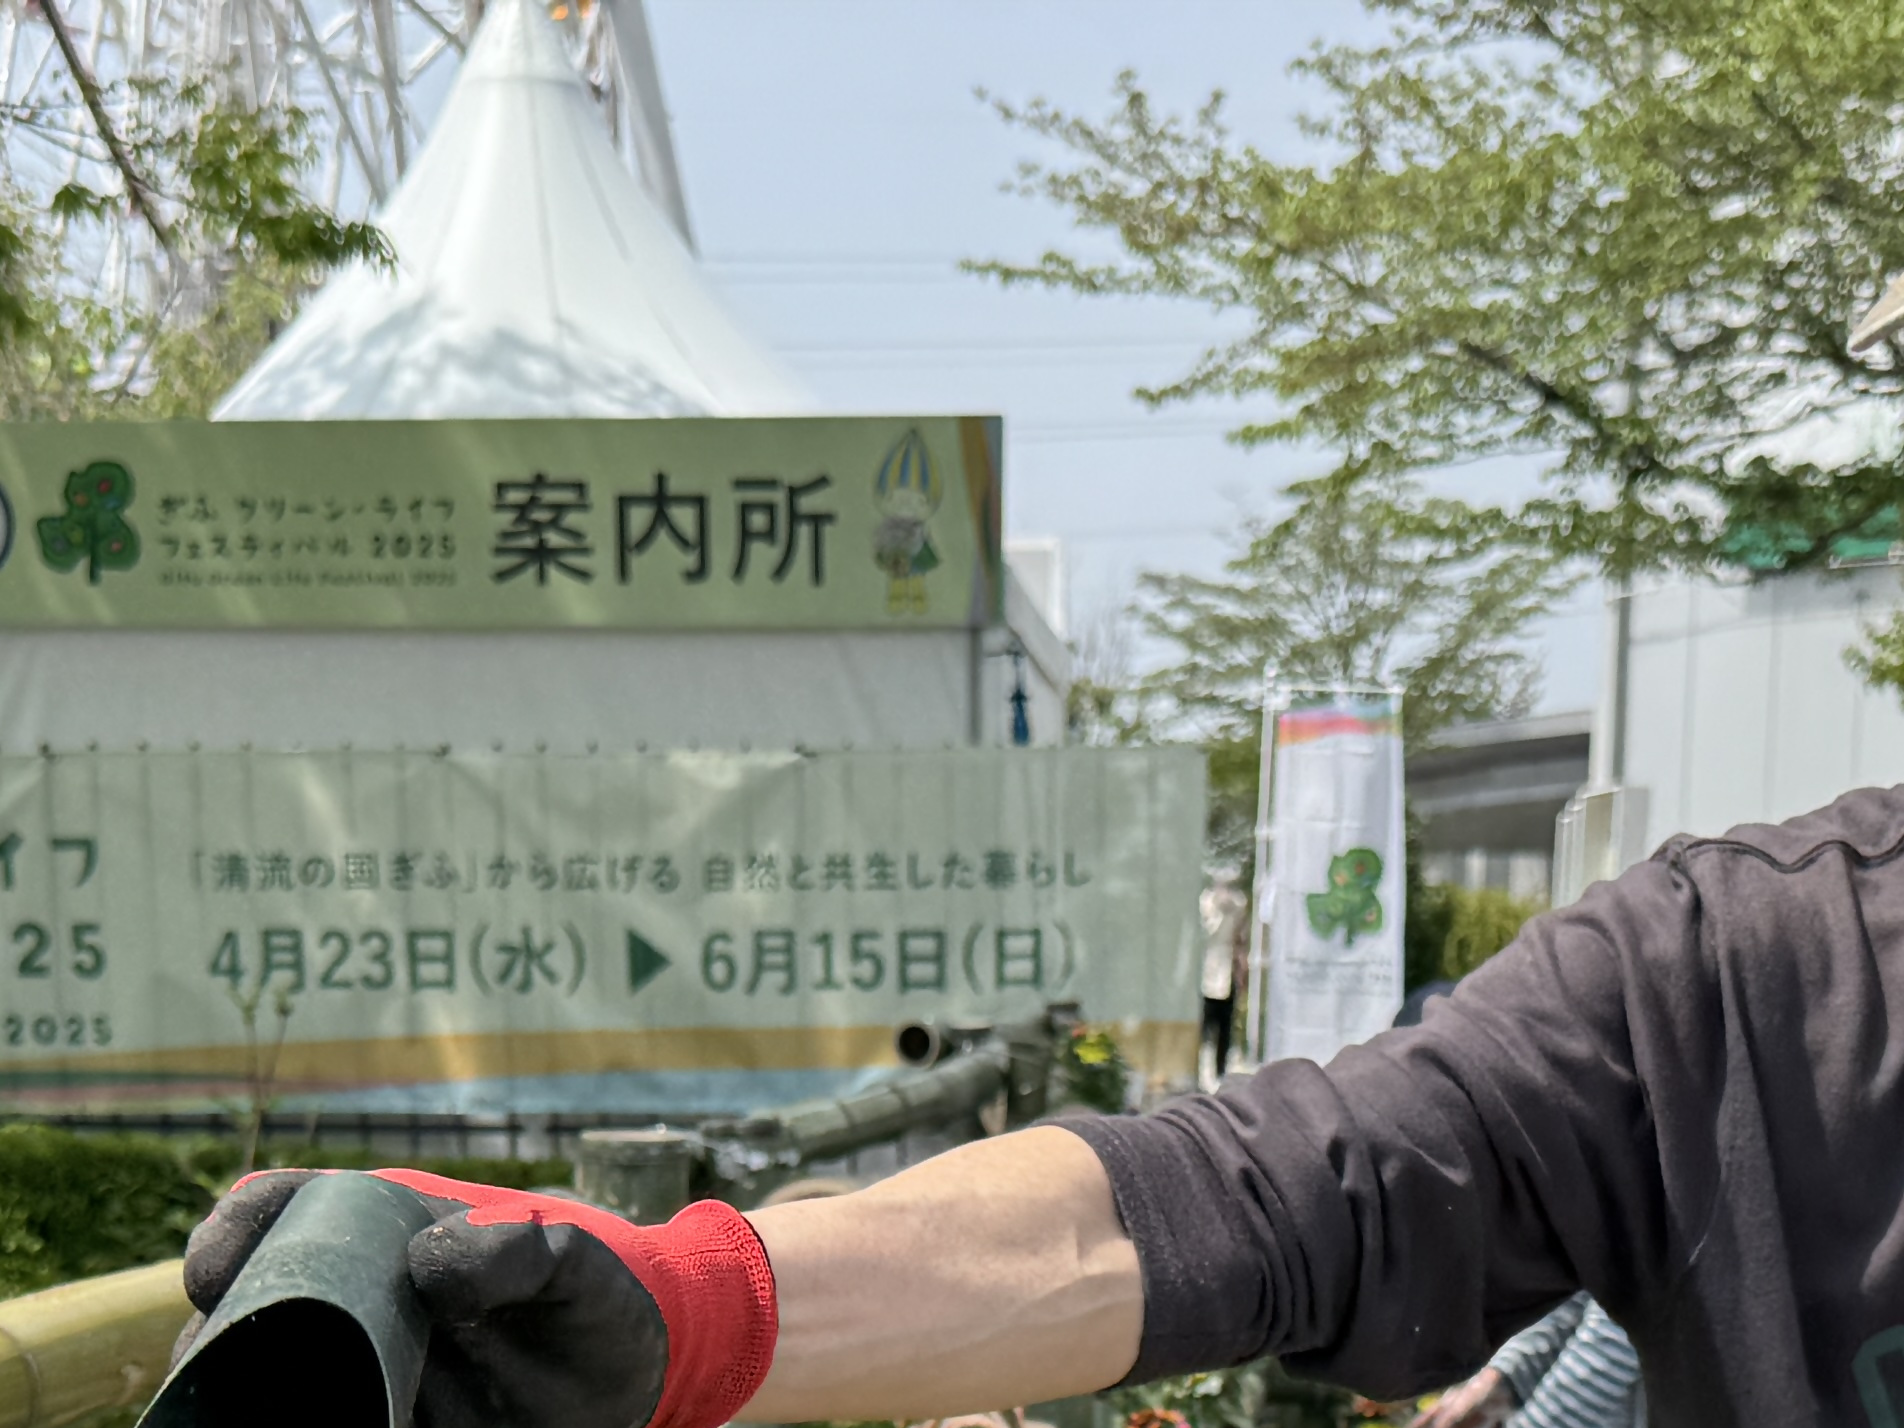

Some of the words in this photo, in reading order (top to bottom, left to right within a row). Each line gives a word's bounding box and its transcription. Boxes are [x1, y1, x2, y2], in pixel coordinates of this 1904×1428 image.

[490, 471, 839, 586] 案内所
[370, 533, 457, 560] 2025
[3, 1013, 114, 1047] 2025
